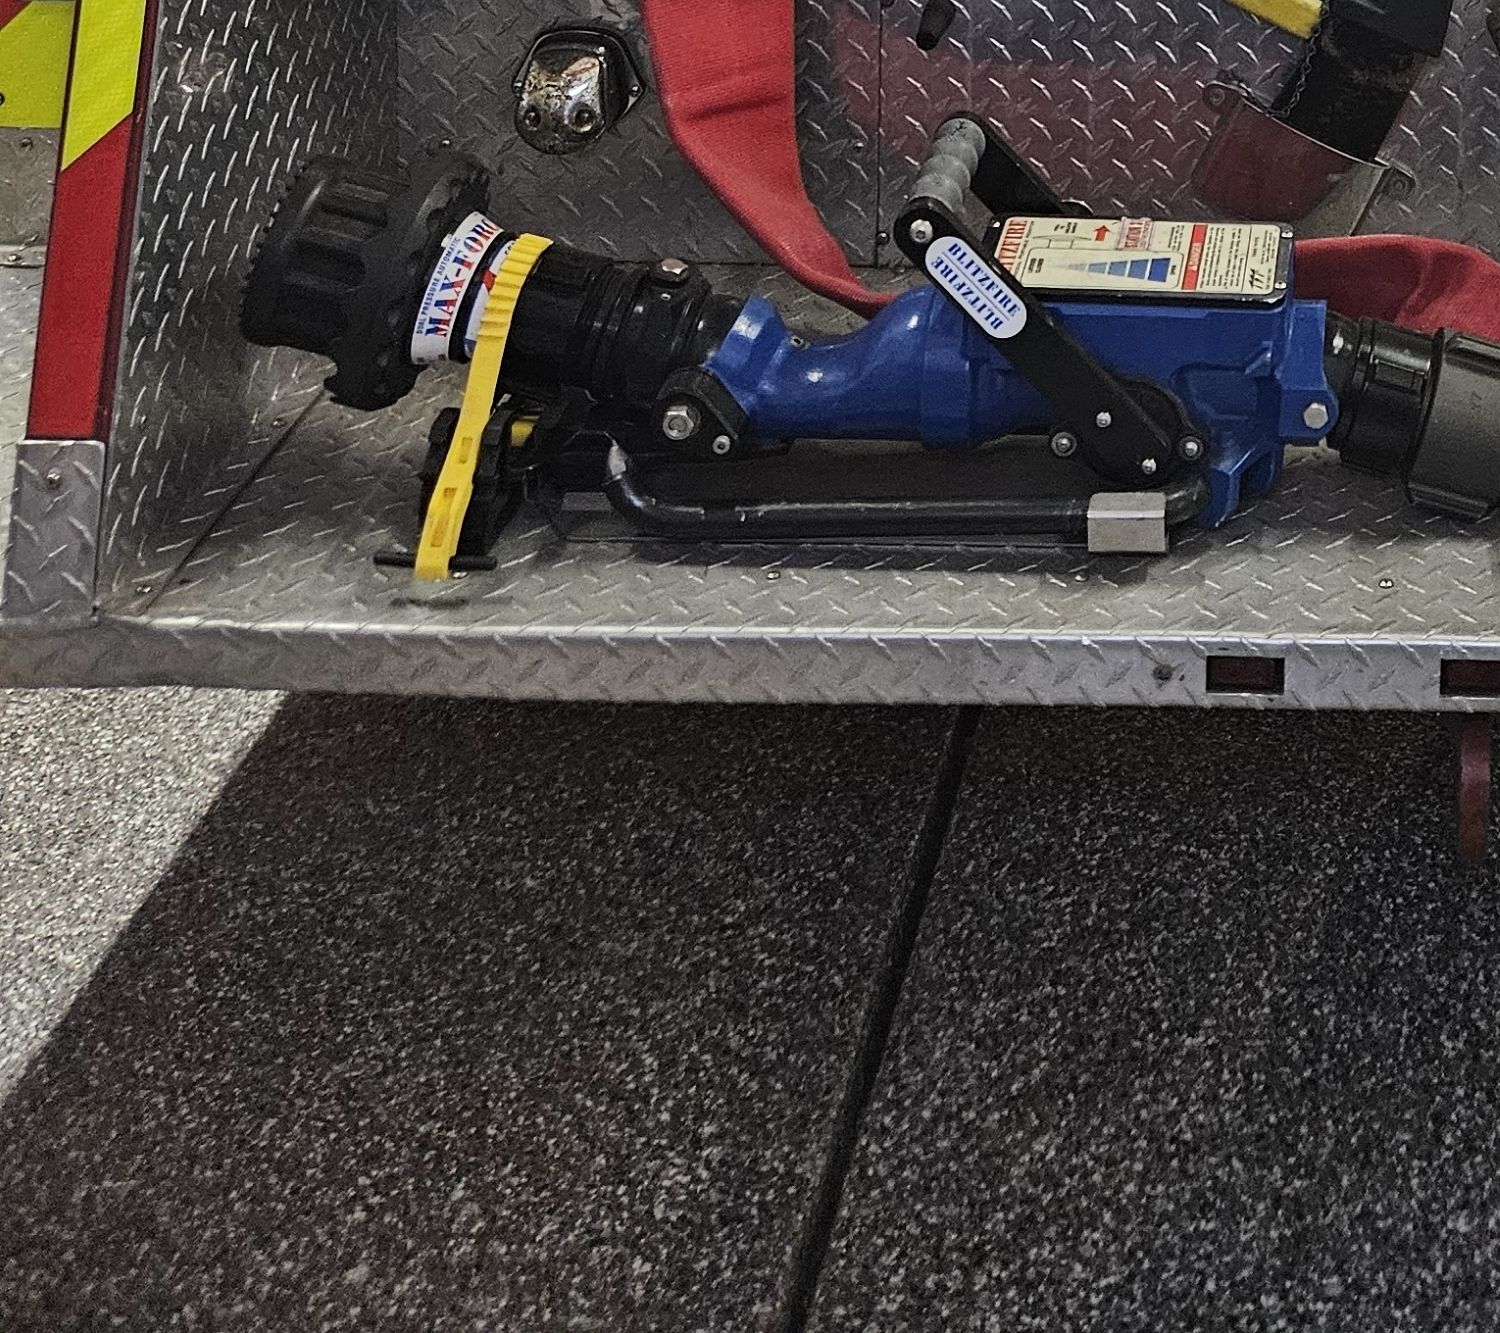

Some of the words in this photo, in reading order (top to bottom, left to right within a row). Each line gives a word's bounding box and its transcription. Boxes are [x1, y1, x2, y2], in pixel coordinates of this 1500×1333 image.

[421, 277, 440, 316] PRESSURE
[437, 236, 461, 277] AUTOMATIC
[425, 218, 500, 338] MAX-FORC
[931, 256, 1004, 330] BLITZFIRE
[948, 242, 1021, 318] BLITZFIRE
